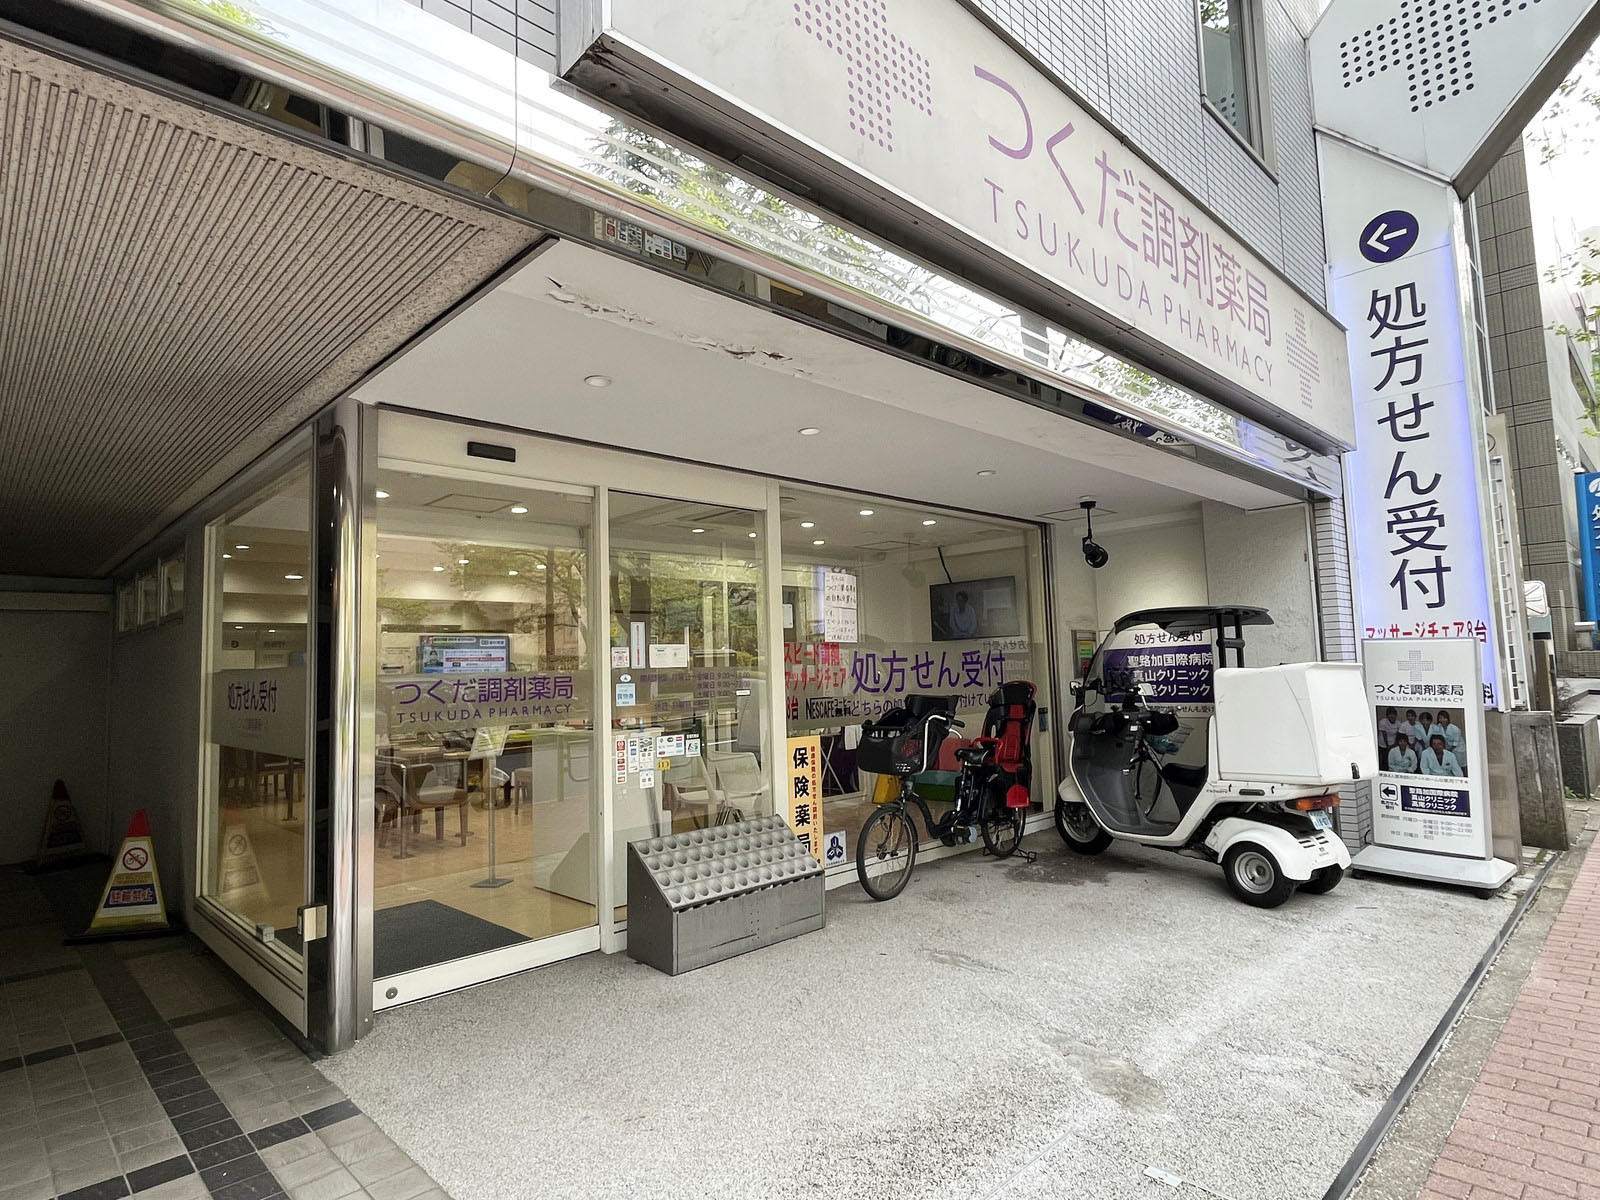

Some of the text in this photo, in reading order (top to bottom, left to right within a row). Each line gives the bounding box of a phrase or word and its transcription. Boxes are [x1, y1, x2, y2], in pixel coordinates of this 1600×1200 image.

[973, 64, 1272, 348] つくだ調剤薬局
[984, 177, 1274, 388] TSUKUDA PHARMACY
[1366, 281, 1452, 612] 処方せん受付
[1134, 632, 1203, 645] 処方せん受付
[851, 649, 1005, 694] 処方せん受付
[1127, 653, 1213, 668] 聖路加国際病院
[227, 681, 277, 712] 処方せん受付
[395, 675, 574, 705] つくだ調剤薬局
[1134, 683, 1210, 697] クリニック
[1374, 684, 1464, 696] つくだ調剤薬局
[397, 704, 572, 724] TSUKUDA PHARMACY
